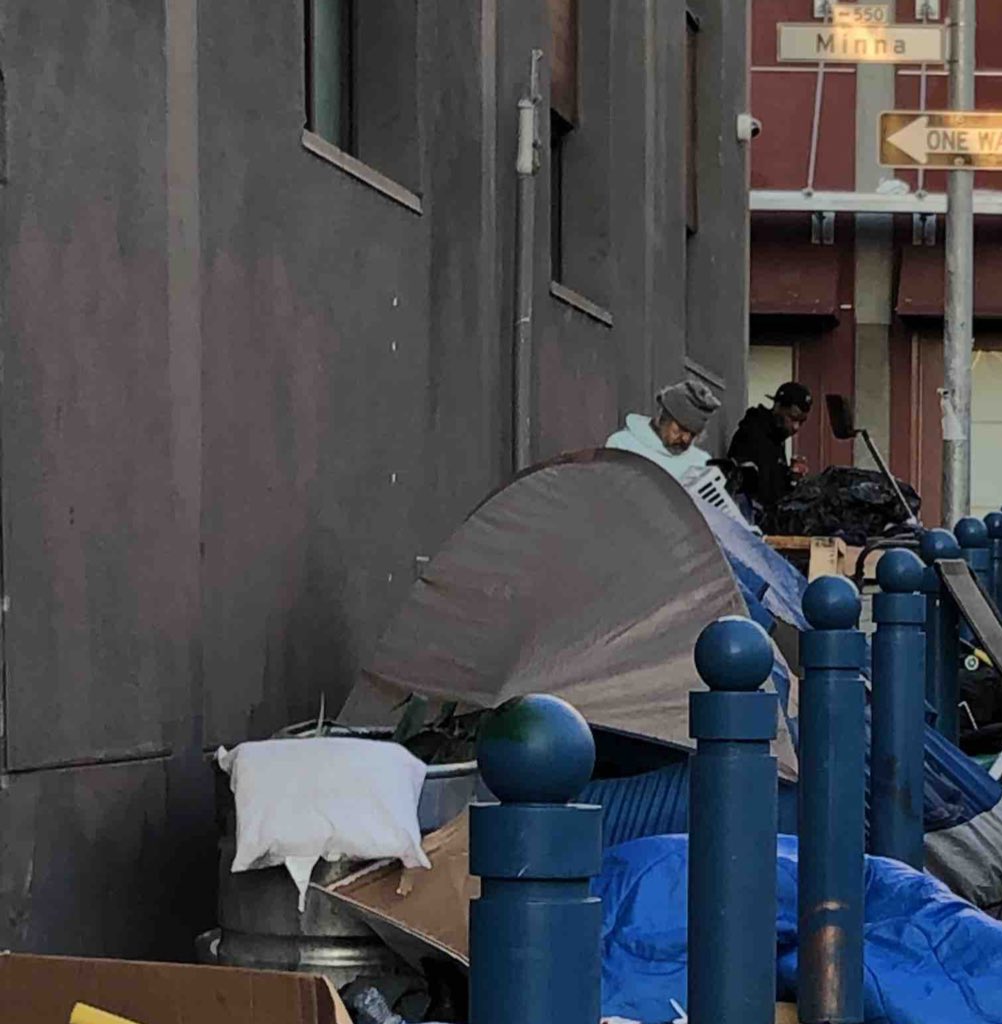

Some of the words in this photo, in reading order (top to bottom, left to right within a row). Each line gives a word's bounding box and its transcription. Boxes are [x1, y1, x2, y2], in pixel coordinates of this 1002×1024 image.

[853, 7, 885, 22] 550
[816, 33, 907, 54] Minna
[927, 130, 969, 151] ONE
